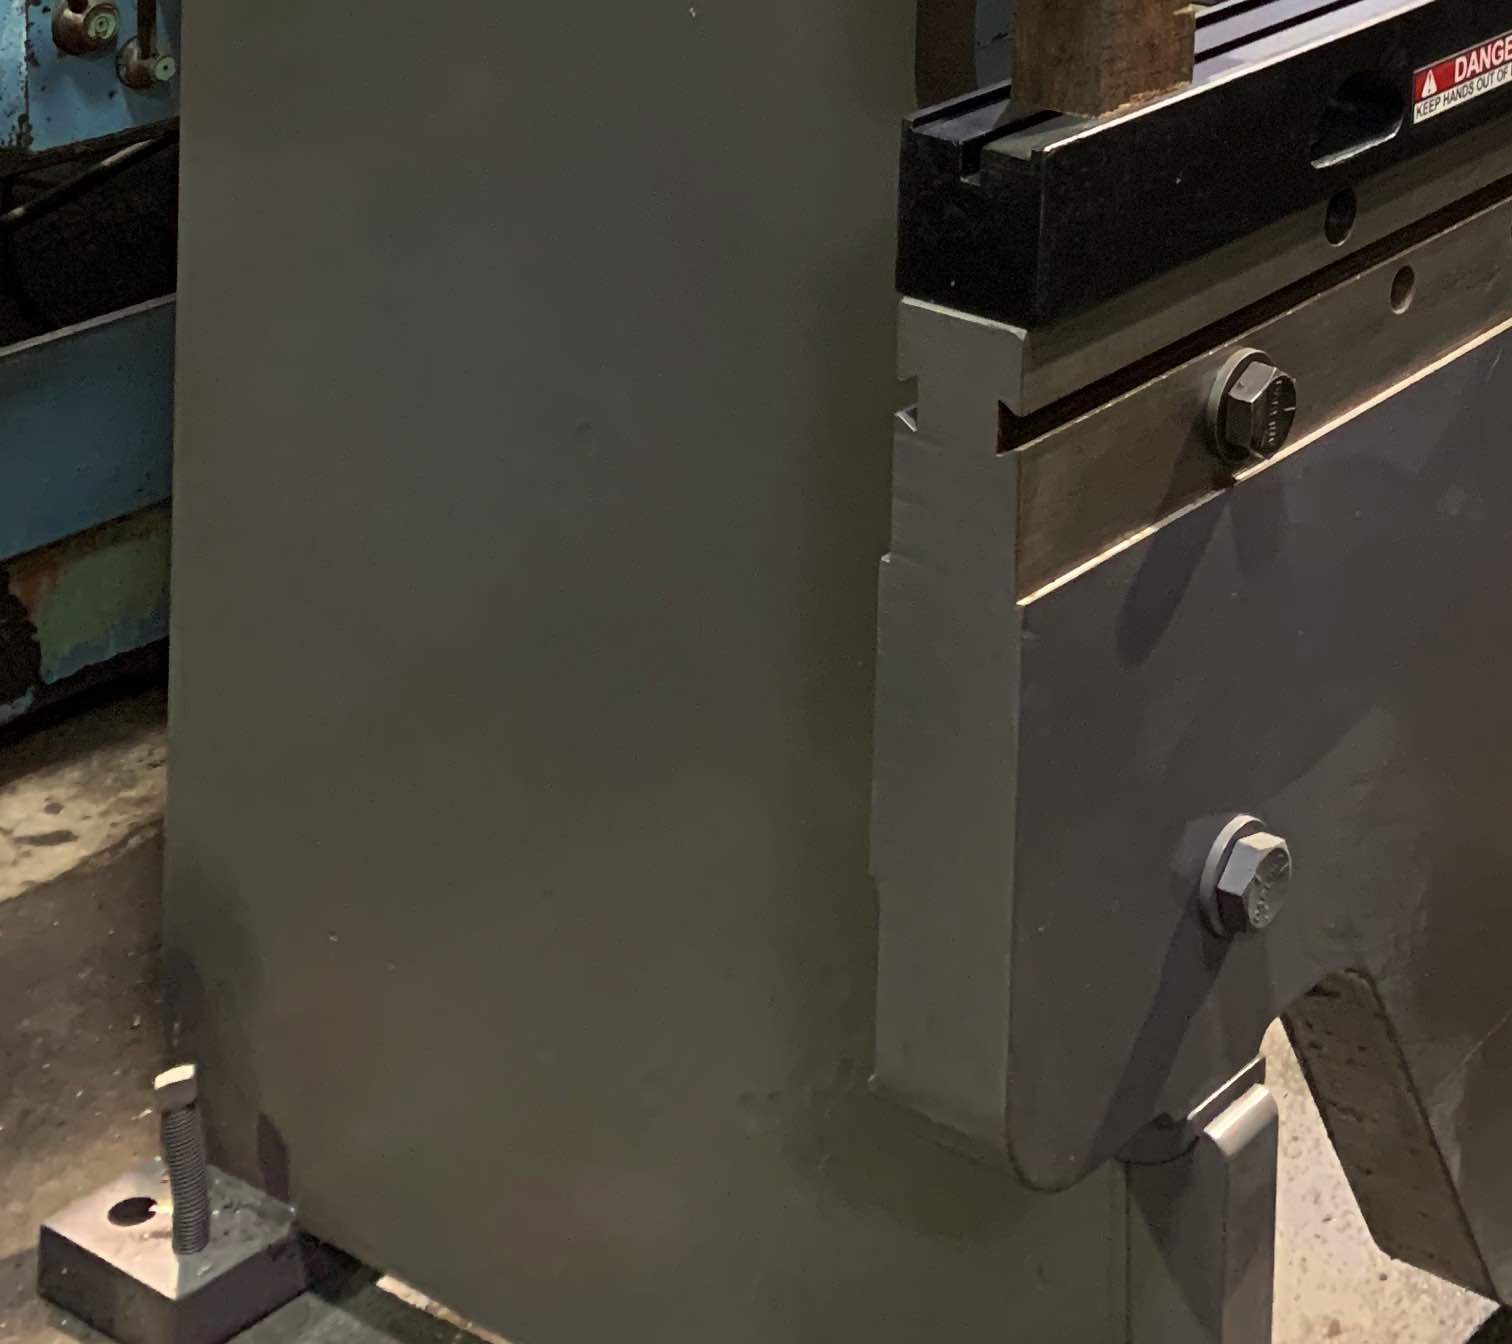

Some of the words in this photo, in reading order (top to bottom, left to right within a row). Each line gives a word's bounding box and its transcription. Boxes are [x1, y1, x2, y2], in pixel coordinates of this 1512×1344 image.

[1416, 97, 1440, 120] KEEP
[1442, 84, 1474, 107] HANDS
[1476, 76, 1495, 92] OUT
[1496, 68, 1510, 83] OF
